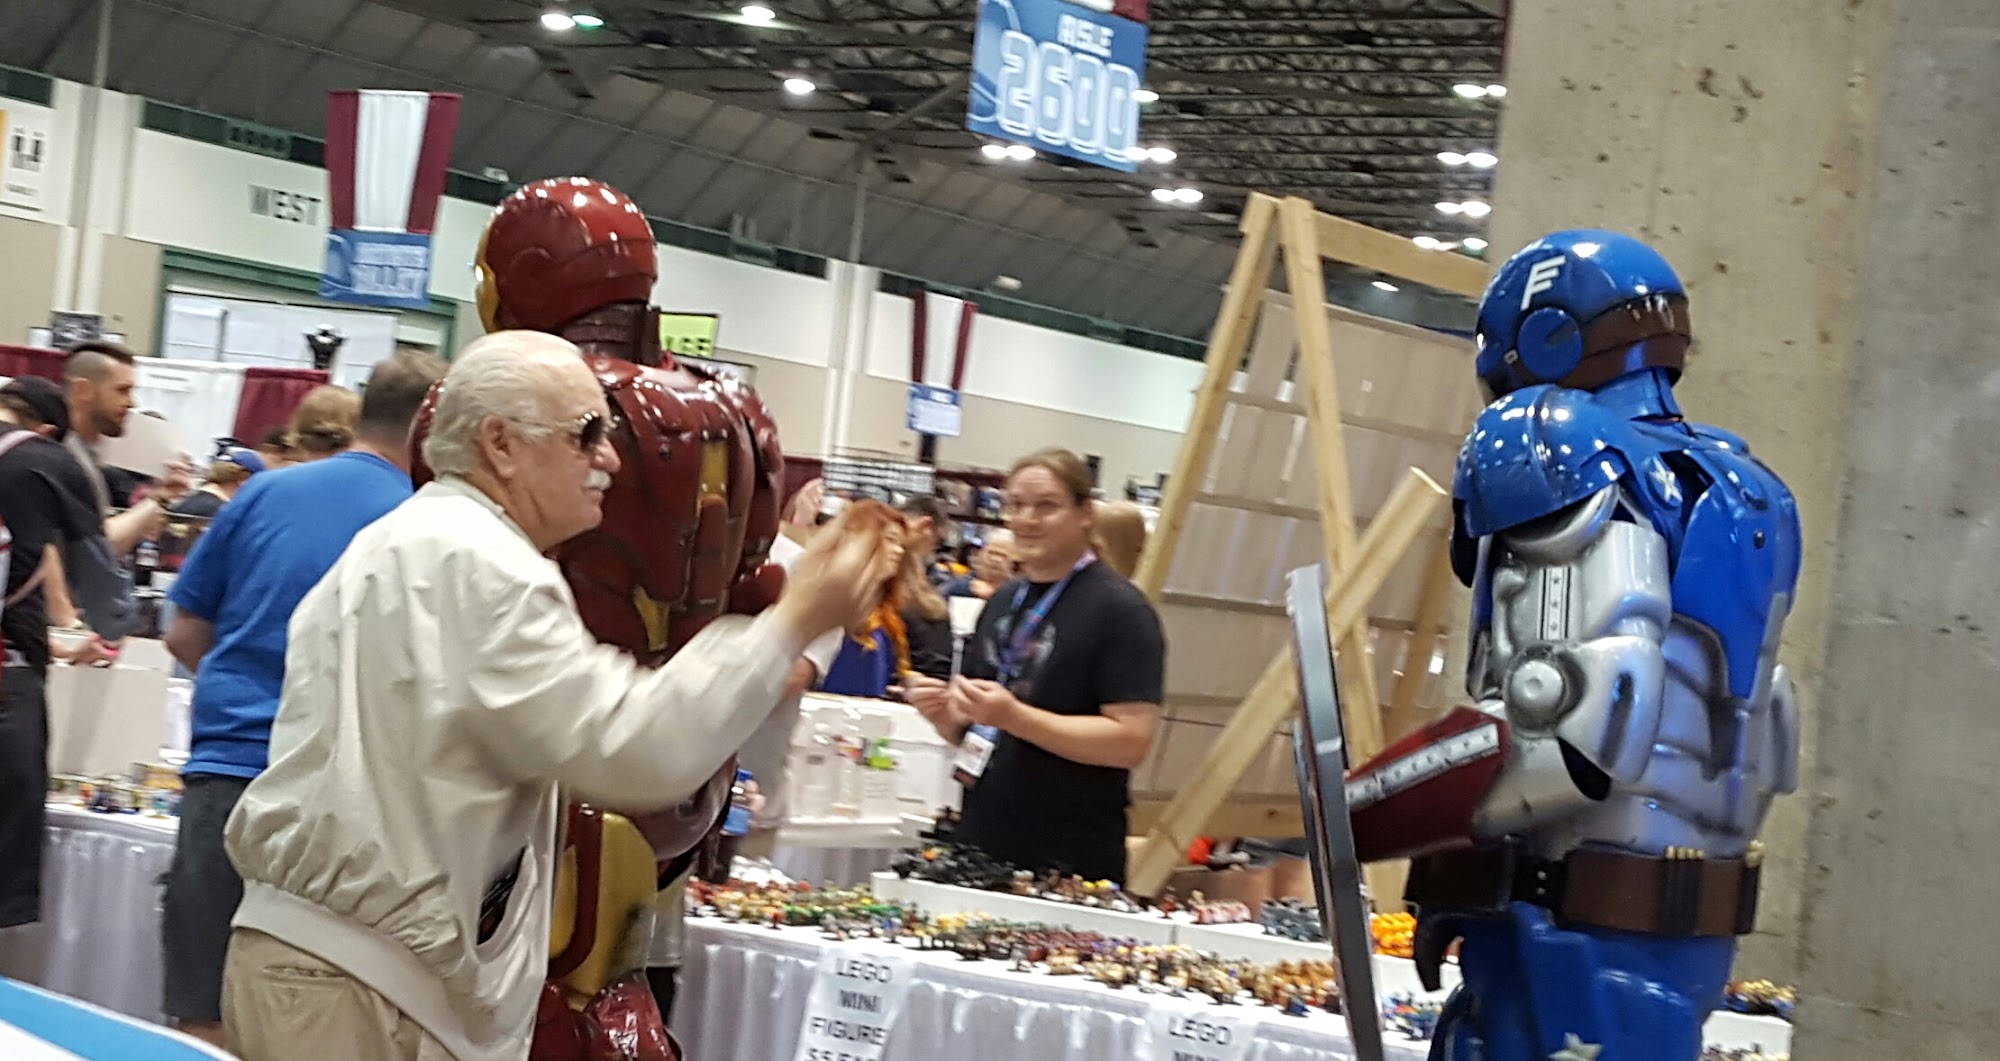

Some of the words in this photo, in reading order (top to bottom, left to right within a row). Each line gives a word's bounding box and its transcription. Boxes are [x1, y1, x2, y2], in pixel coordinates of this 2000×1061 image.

[1056, 13, 1115, 58] AISLE
[996, 29, 1141, 163] 2600
[247, 183, 322, 226] WEST
[836, 958, 893, 984] LEGO
[1168, 1016, 1233, 1046] LEGO
